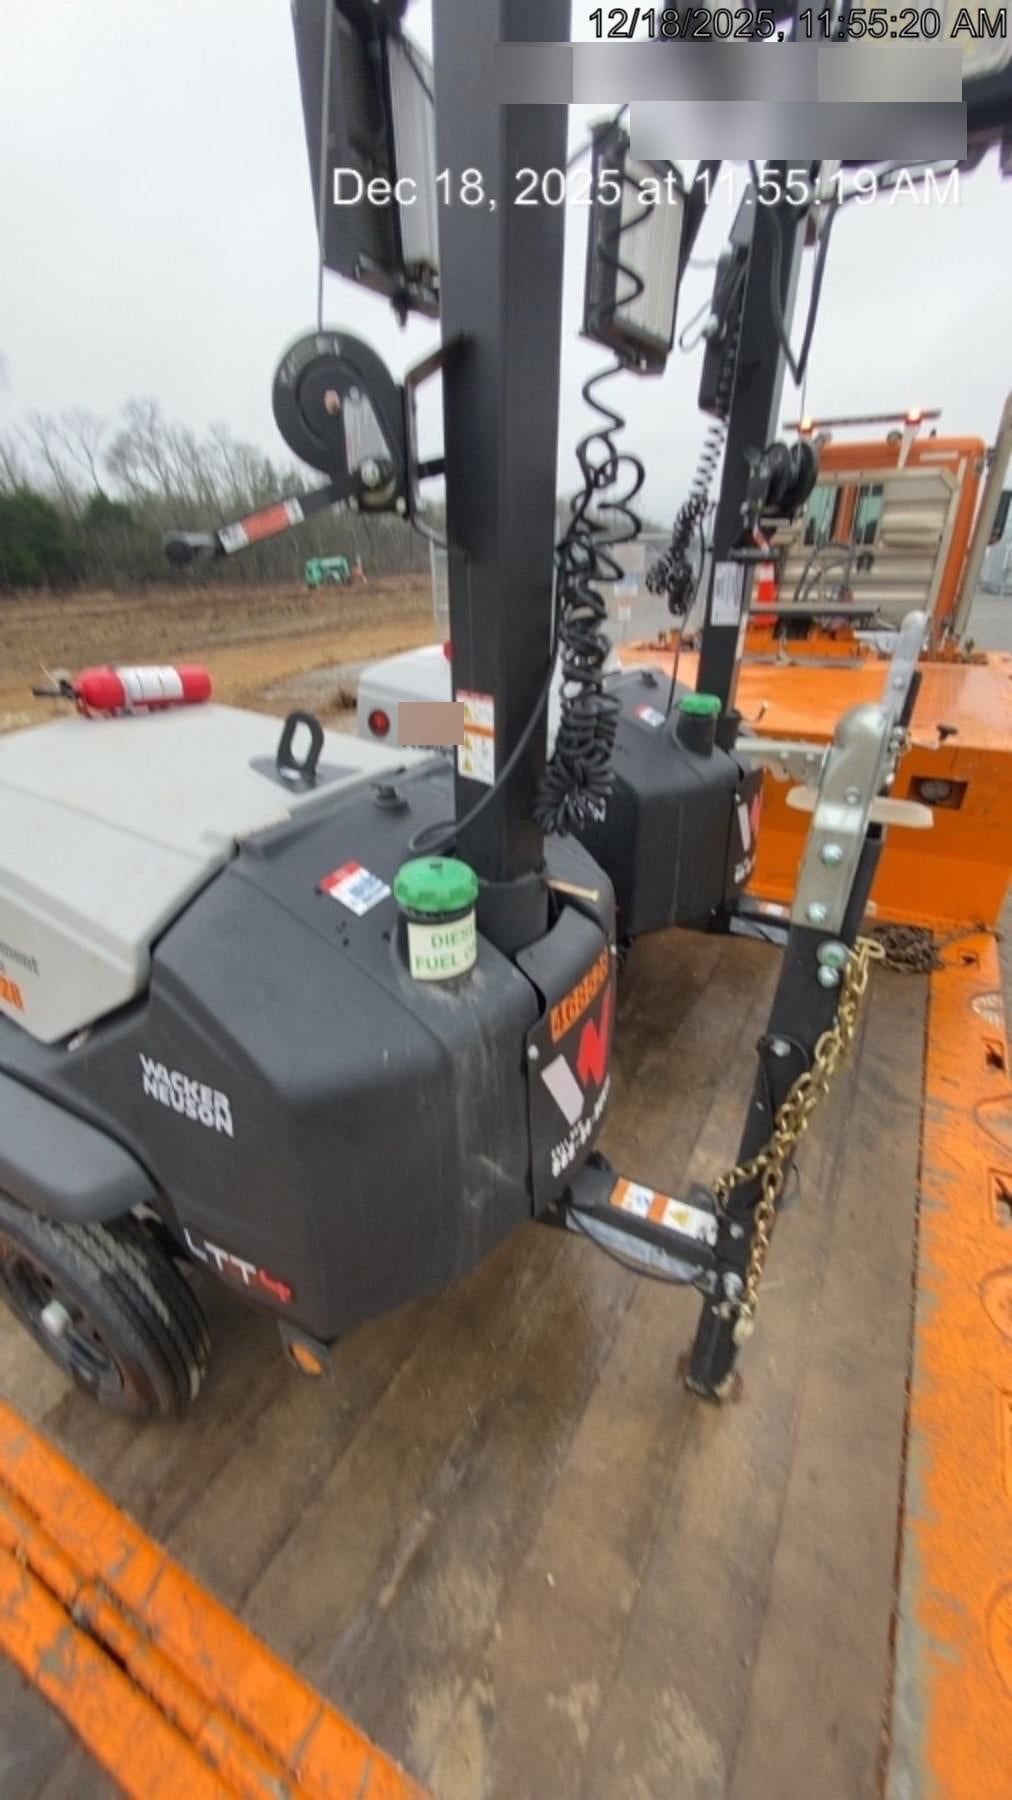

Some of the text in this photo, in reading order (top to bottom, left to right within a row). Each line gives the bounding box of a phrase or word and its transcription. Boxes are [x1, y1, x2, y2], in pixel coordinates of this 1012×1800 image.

[415, 953, 457, 971] FUEL
[138, 1052, 230, 1106] WACKER
[142, 1072, 234, 1138] NEUSON
[183, 1227, 293, 1305] LTT4
